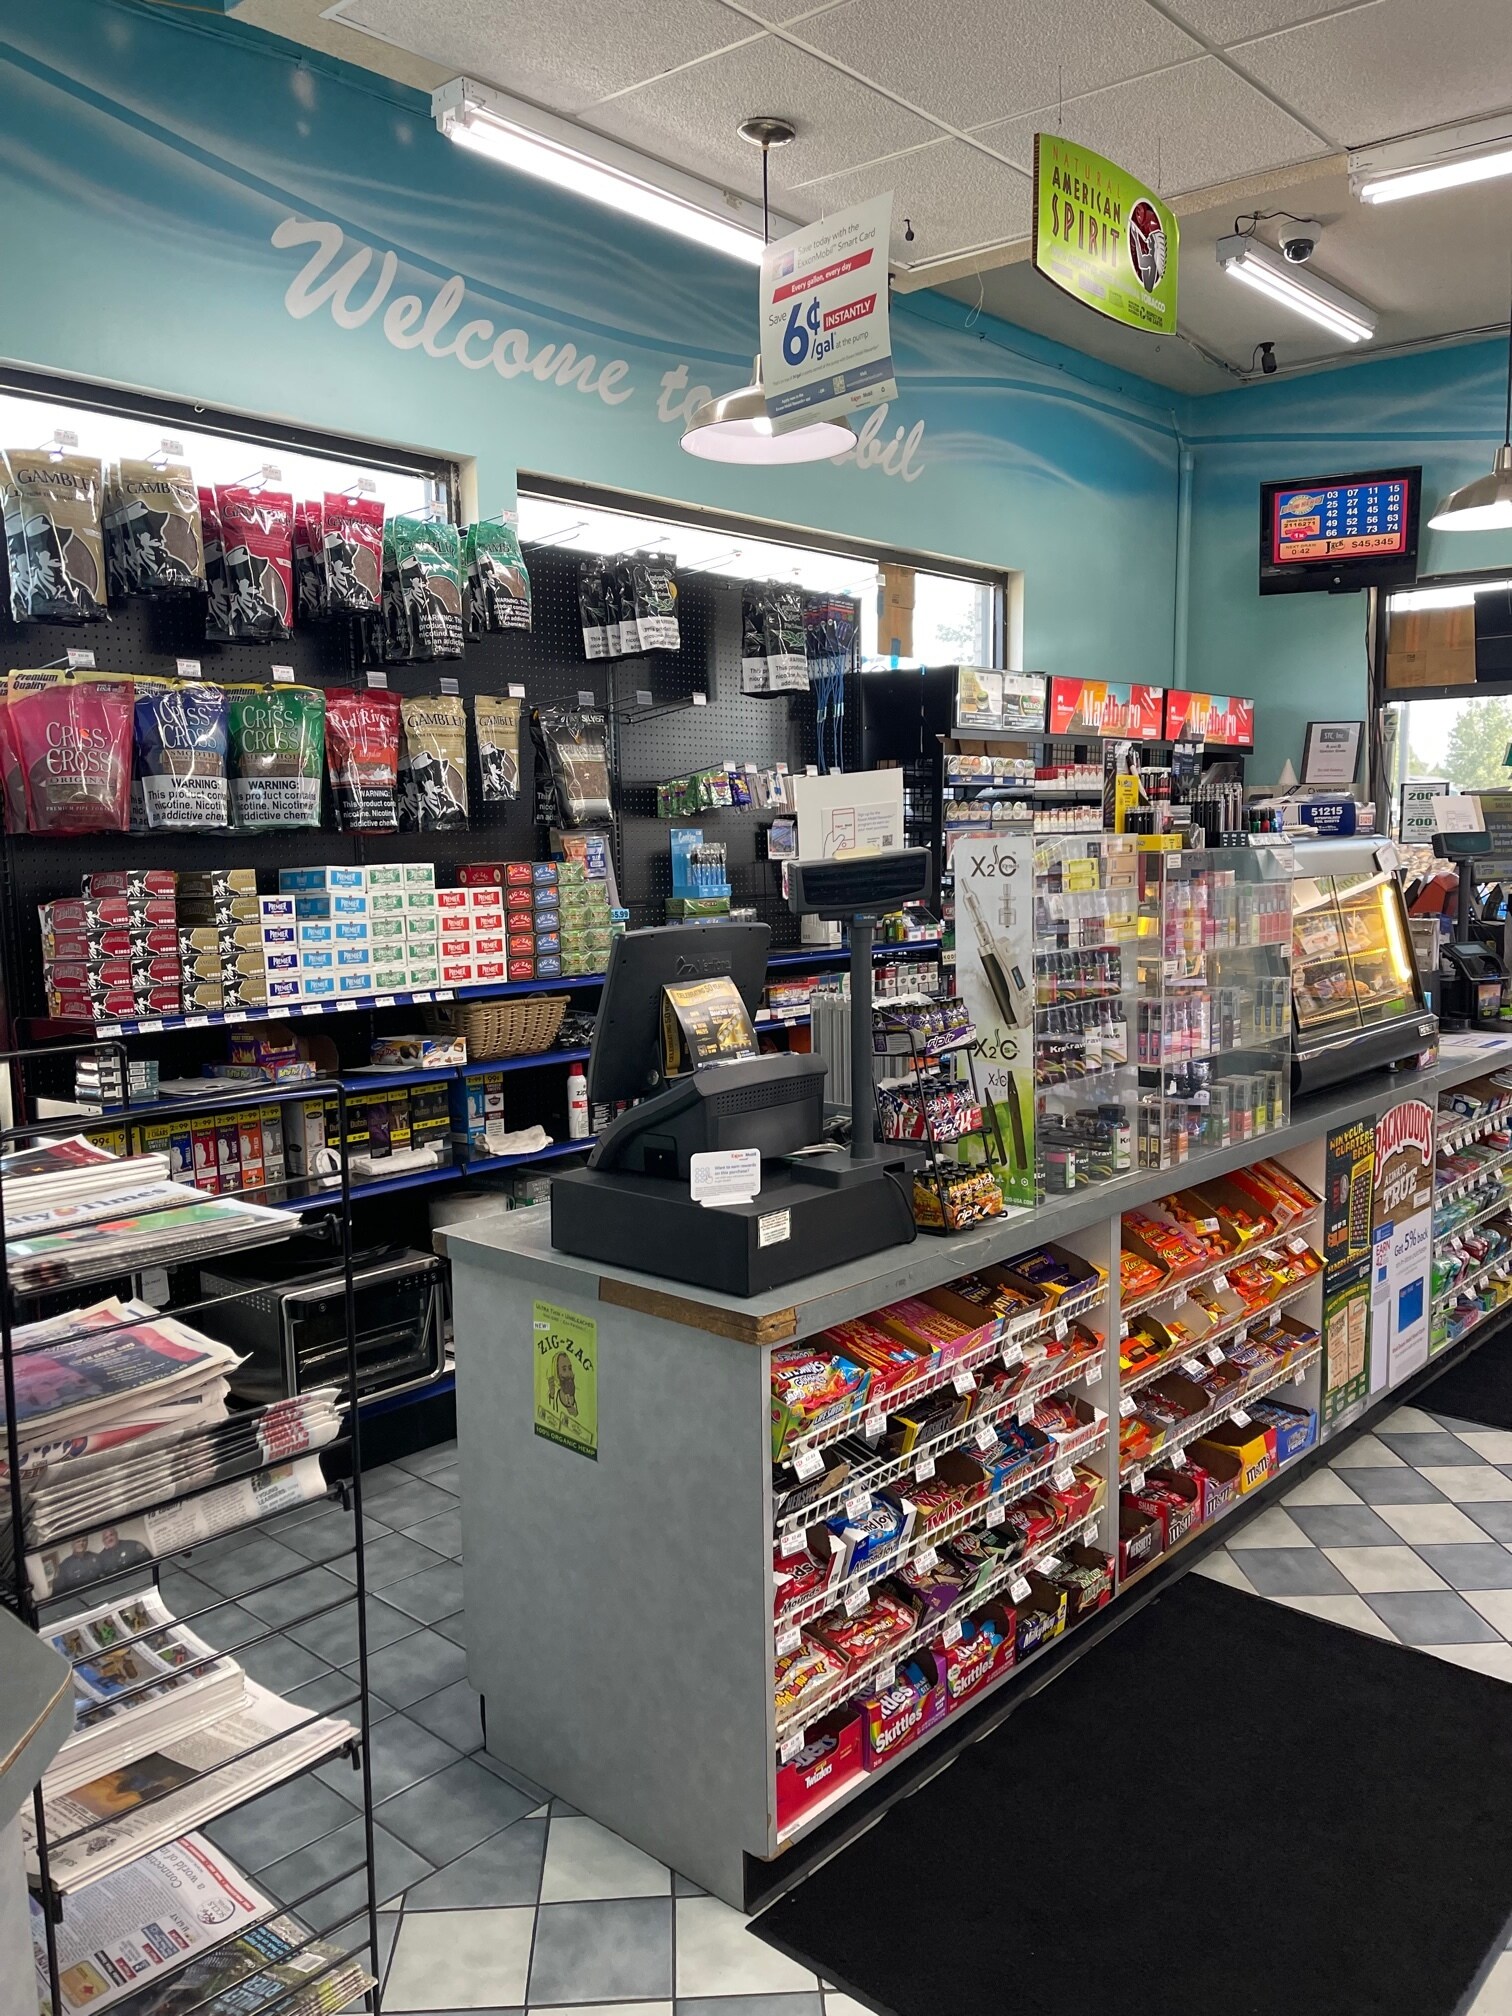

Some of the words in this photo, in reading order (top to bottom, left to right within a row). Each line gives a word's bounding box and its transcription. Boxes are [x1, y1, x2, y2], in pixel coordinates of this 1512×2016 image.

[1053, 144, 1120, 199] NATURAL
[1052, 166, 1120, 225] AMERICAN
[814, 236, 831, 248] today
[832, 229, 846, 240] with
[838, 237, 858, 251] Smart
[859, 228, 875, 242] Card
[1052, 193, 1120, 268] SPIRIT
[792, 282, 806, 292] Every
[807, 275, 824, 288] gallon,
[825, 268, 840, 278] every
[271, 217, 635, 405] Welcome
[769, 311, 787, 326] Save
[826, 300, 871, 327] INSTANTLY
[852, 331, 868, 344] pump
[1352, 538, 1394, 548] $45,345
[13, 681, 46, 690] Quality
[15, 674, 58, 682] Premium
[330, 713, 358, 728] Red
[1082, 690, 1140, 728] Marlboro
[1191, 702, 1236, 736] Marlboro
[242, 729, 300, 752] CROSS
[46, 748, 111, 774] CROSS
[148, 790, 166, 799] This
[172, 778, 221, 789] WARNING:
[248, 781, 300, 790] WARNING:
[155, 800, 193, 810] nicotine.
[246, 792, 282, 802] product
[162, 810, 202, 820] addictive
[1311, 806, 1343, 816] 51215
[269, 903, 288, 911] PREMIER
[270, 930, 288, 938] PREMIER
[1336, 1128, 1374, 1158] QUARTERS
[1374, 1102, 1432, 1183] BACKWOODS
[1384, 1162, 1407, 1188] ALWAYS
[74, 1188, 168, 1212] Times
[1384, 1166, 1418, 1214] TRUE
[1404, 1228, 1416, 1251] 5%
[1417, 1230, 1428, 1242] back
[537, 1334, 595, 1373] ZIG-ZAG
[535, 1426, 550, 1438] 100%
[550, 1430, 578, 1450] ORGANIC
[578, 1444, 596, 1456] HEMP
[923, 1500, 964, 1533] TWIX
[1138, 1500, 1158, 1514] SHARE
[875, 1512, 893, 1530] Joy
[952, 1658, 994, 1698] Skittles
[876, 1708, 922, 1754] Skittles
[804, 1764, 833, 1789] Twizzlers
[246, 1974, 285, 1998] RIVER
